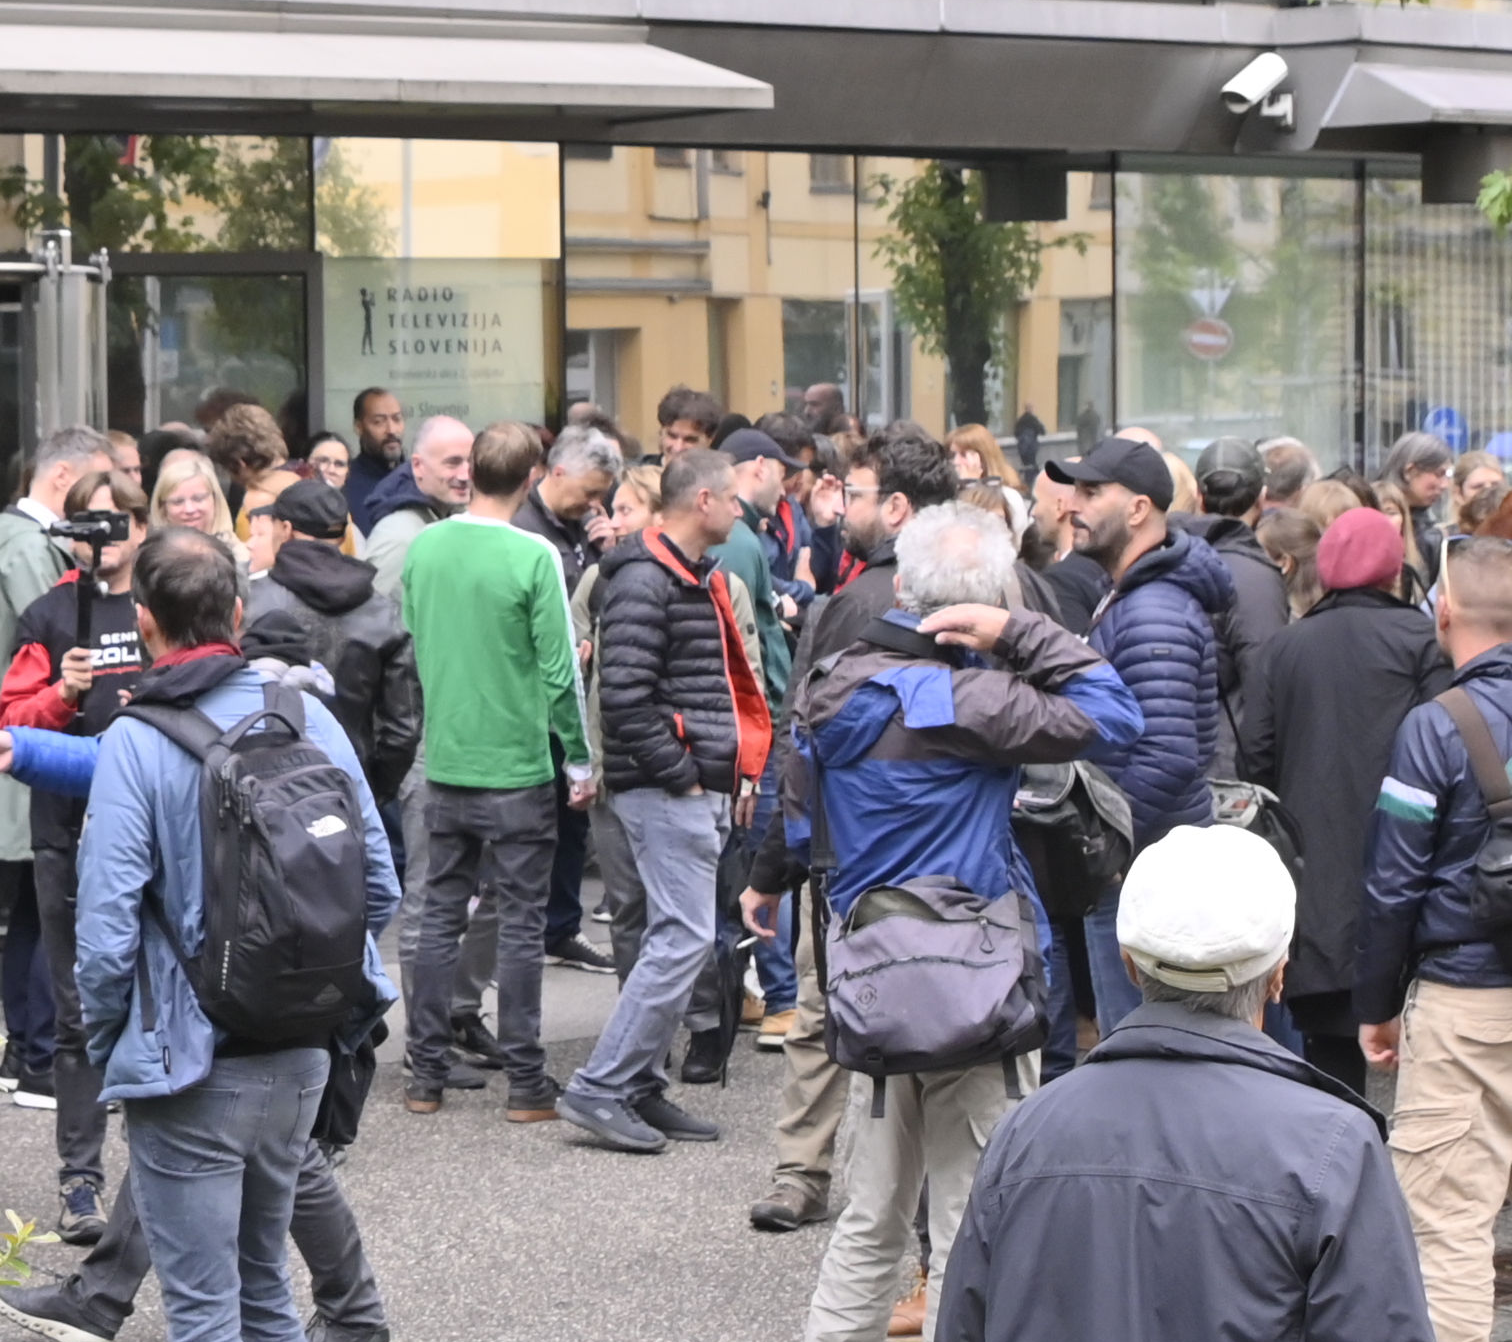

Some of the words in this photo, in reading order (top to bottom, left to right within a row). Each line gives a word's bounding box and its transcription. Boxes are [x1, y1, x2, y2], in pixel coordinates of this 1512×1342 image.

[387, 286, 454, 302] RADIO
[388, 312, 502, 330] TELEVIZIJA
[389, 338, 503, 357] SLOVENIJA
